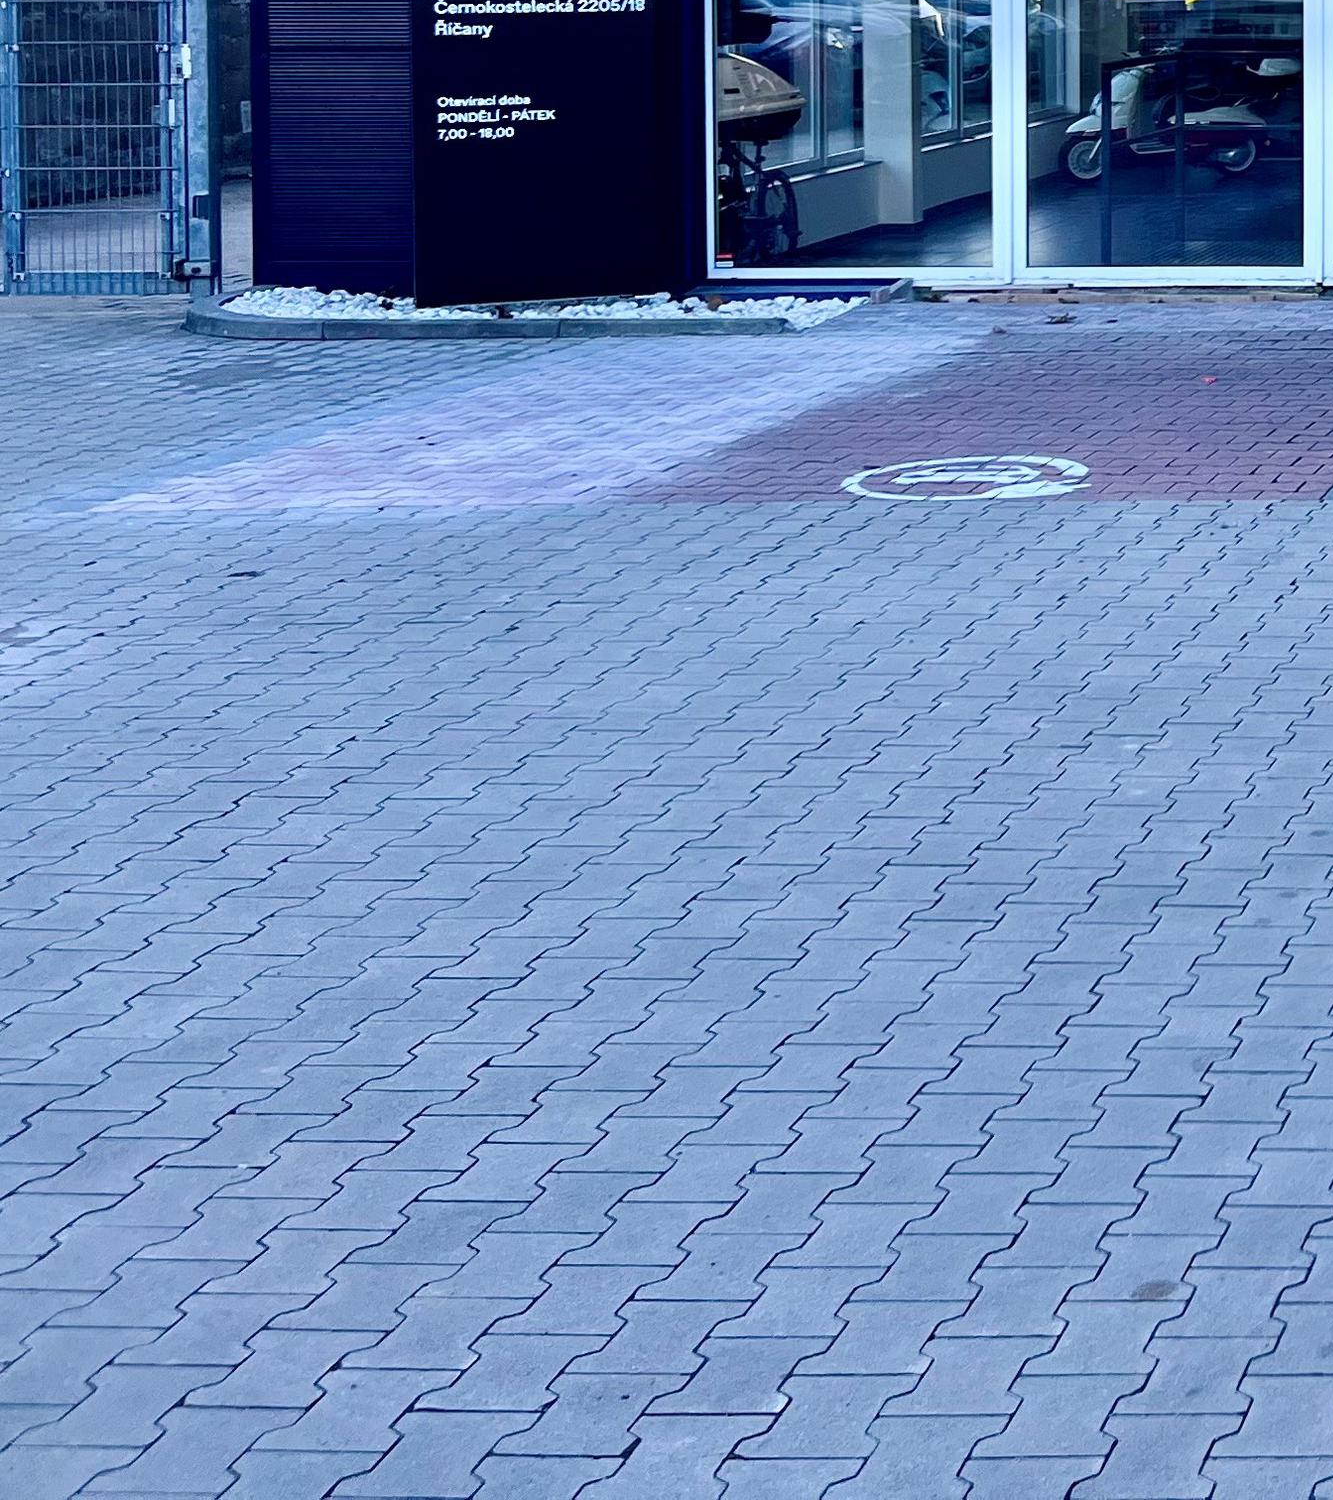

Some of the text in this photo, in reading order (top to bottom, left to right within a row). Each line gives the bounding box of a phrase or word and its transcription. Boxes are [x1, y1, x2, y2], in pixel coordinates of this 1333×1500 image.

[434, 19, 494, 39] Říčany
[436, 94, 531, 108] Otevírací doba
[437, 108, 501, 124] PONDĚLÍ
[511, 108, 557, 121] PÁTEK
[437, 128, 468, 142] 7,00
[478, 126, 515, 140] 18,00
